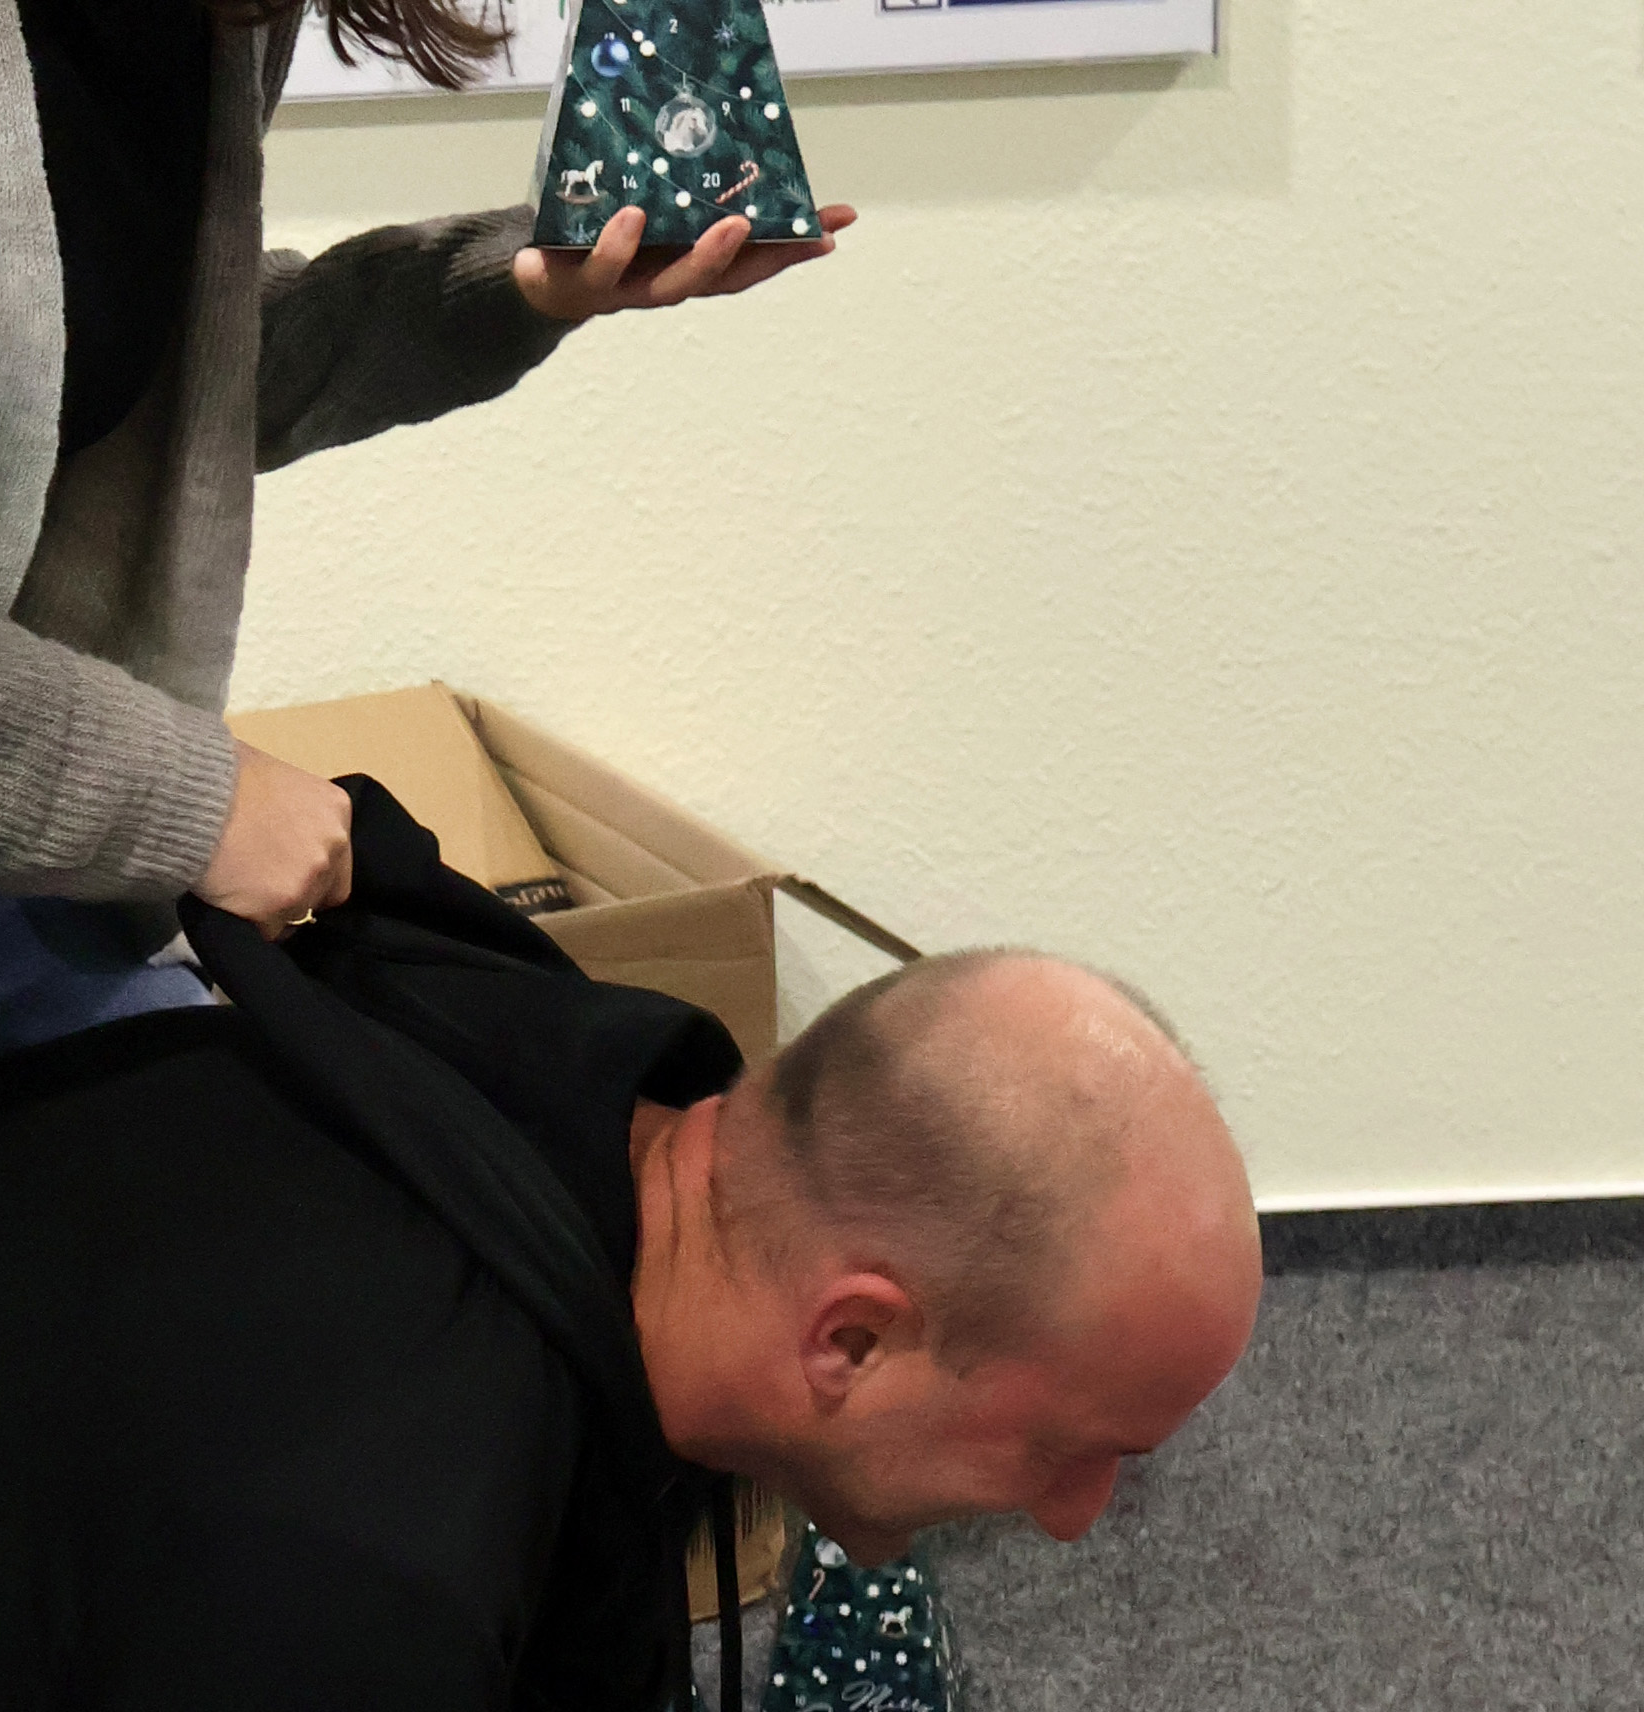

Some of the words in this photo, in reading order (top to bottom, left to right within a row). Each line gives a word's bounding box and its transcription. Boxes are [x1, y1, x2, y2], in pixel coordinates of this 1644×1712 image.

[620, 97, 632, 113] 11
[721, 101, 732, 118] 9
[621, 175, 638, 190] 14
[702, 172, 722, 188] 20
